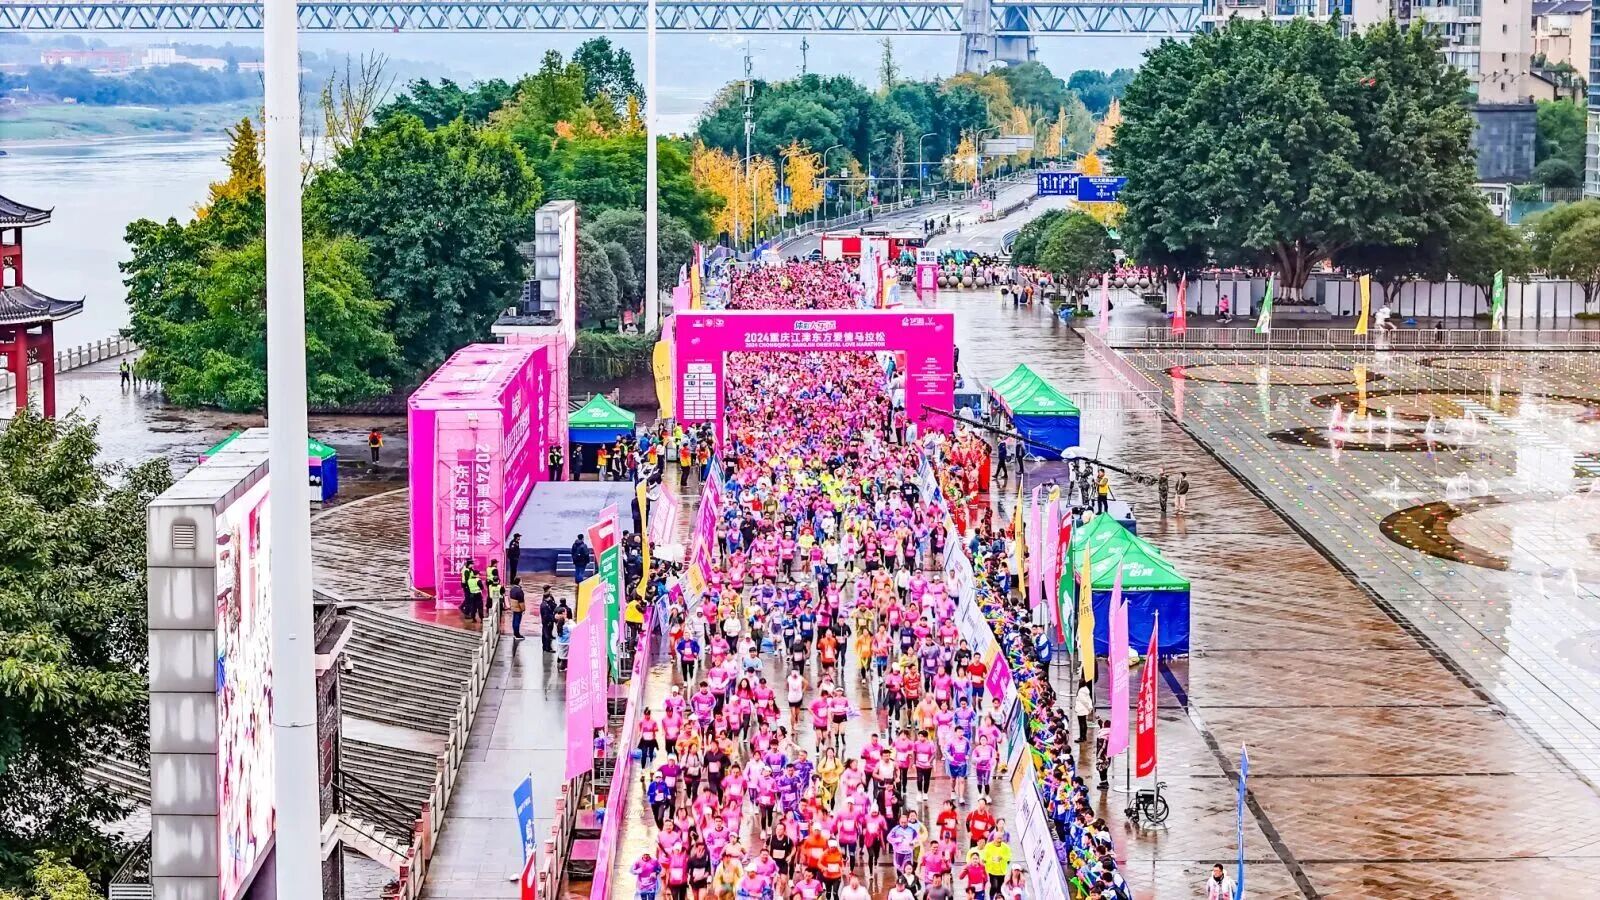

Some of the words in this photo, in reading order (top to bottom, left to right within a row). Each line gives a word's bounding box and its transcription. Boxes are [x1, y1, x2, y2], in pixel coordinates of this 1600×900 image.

[744, 332, 885, 343] 2024重庆江津东方爱情马拉松
[475, 443, 491, 545] 2024重庆江津
